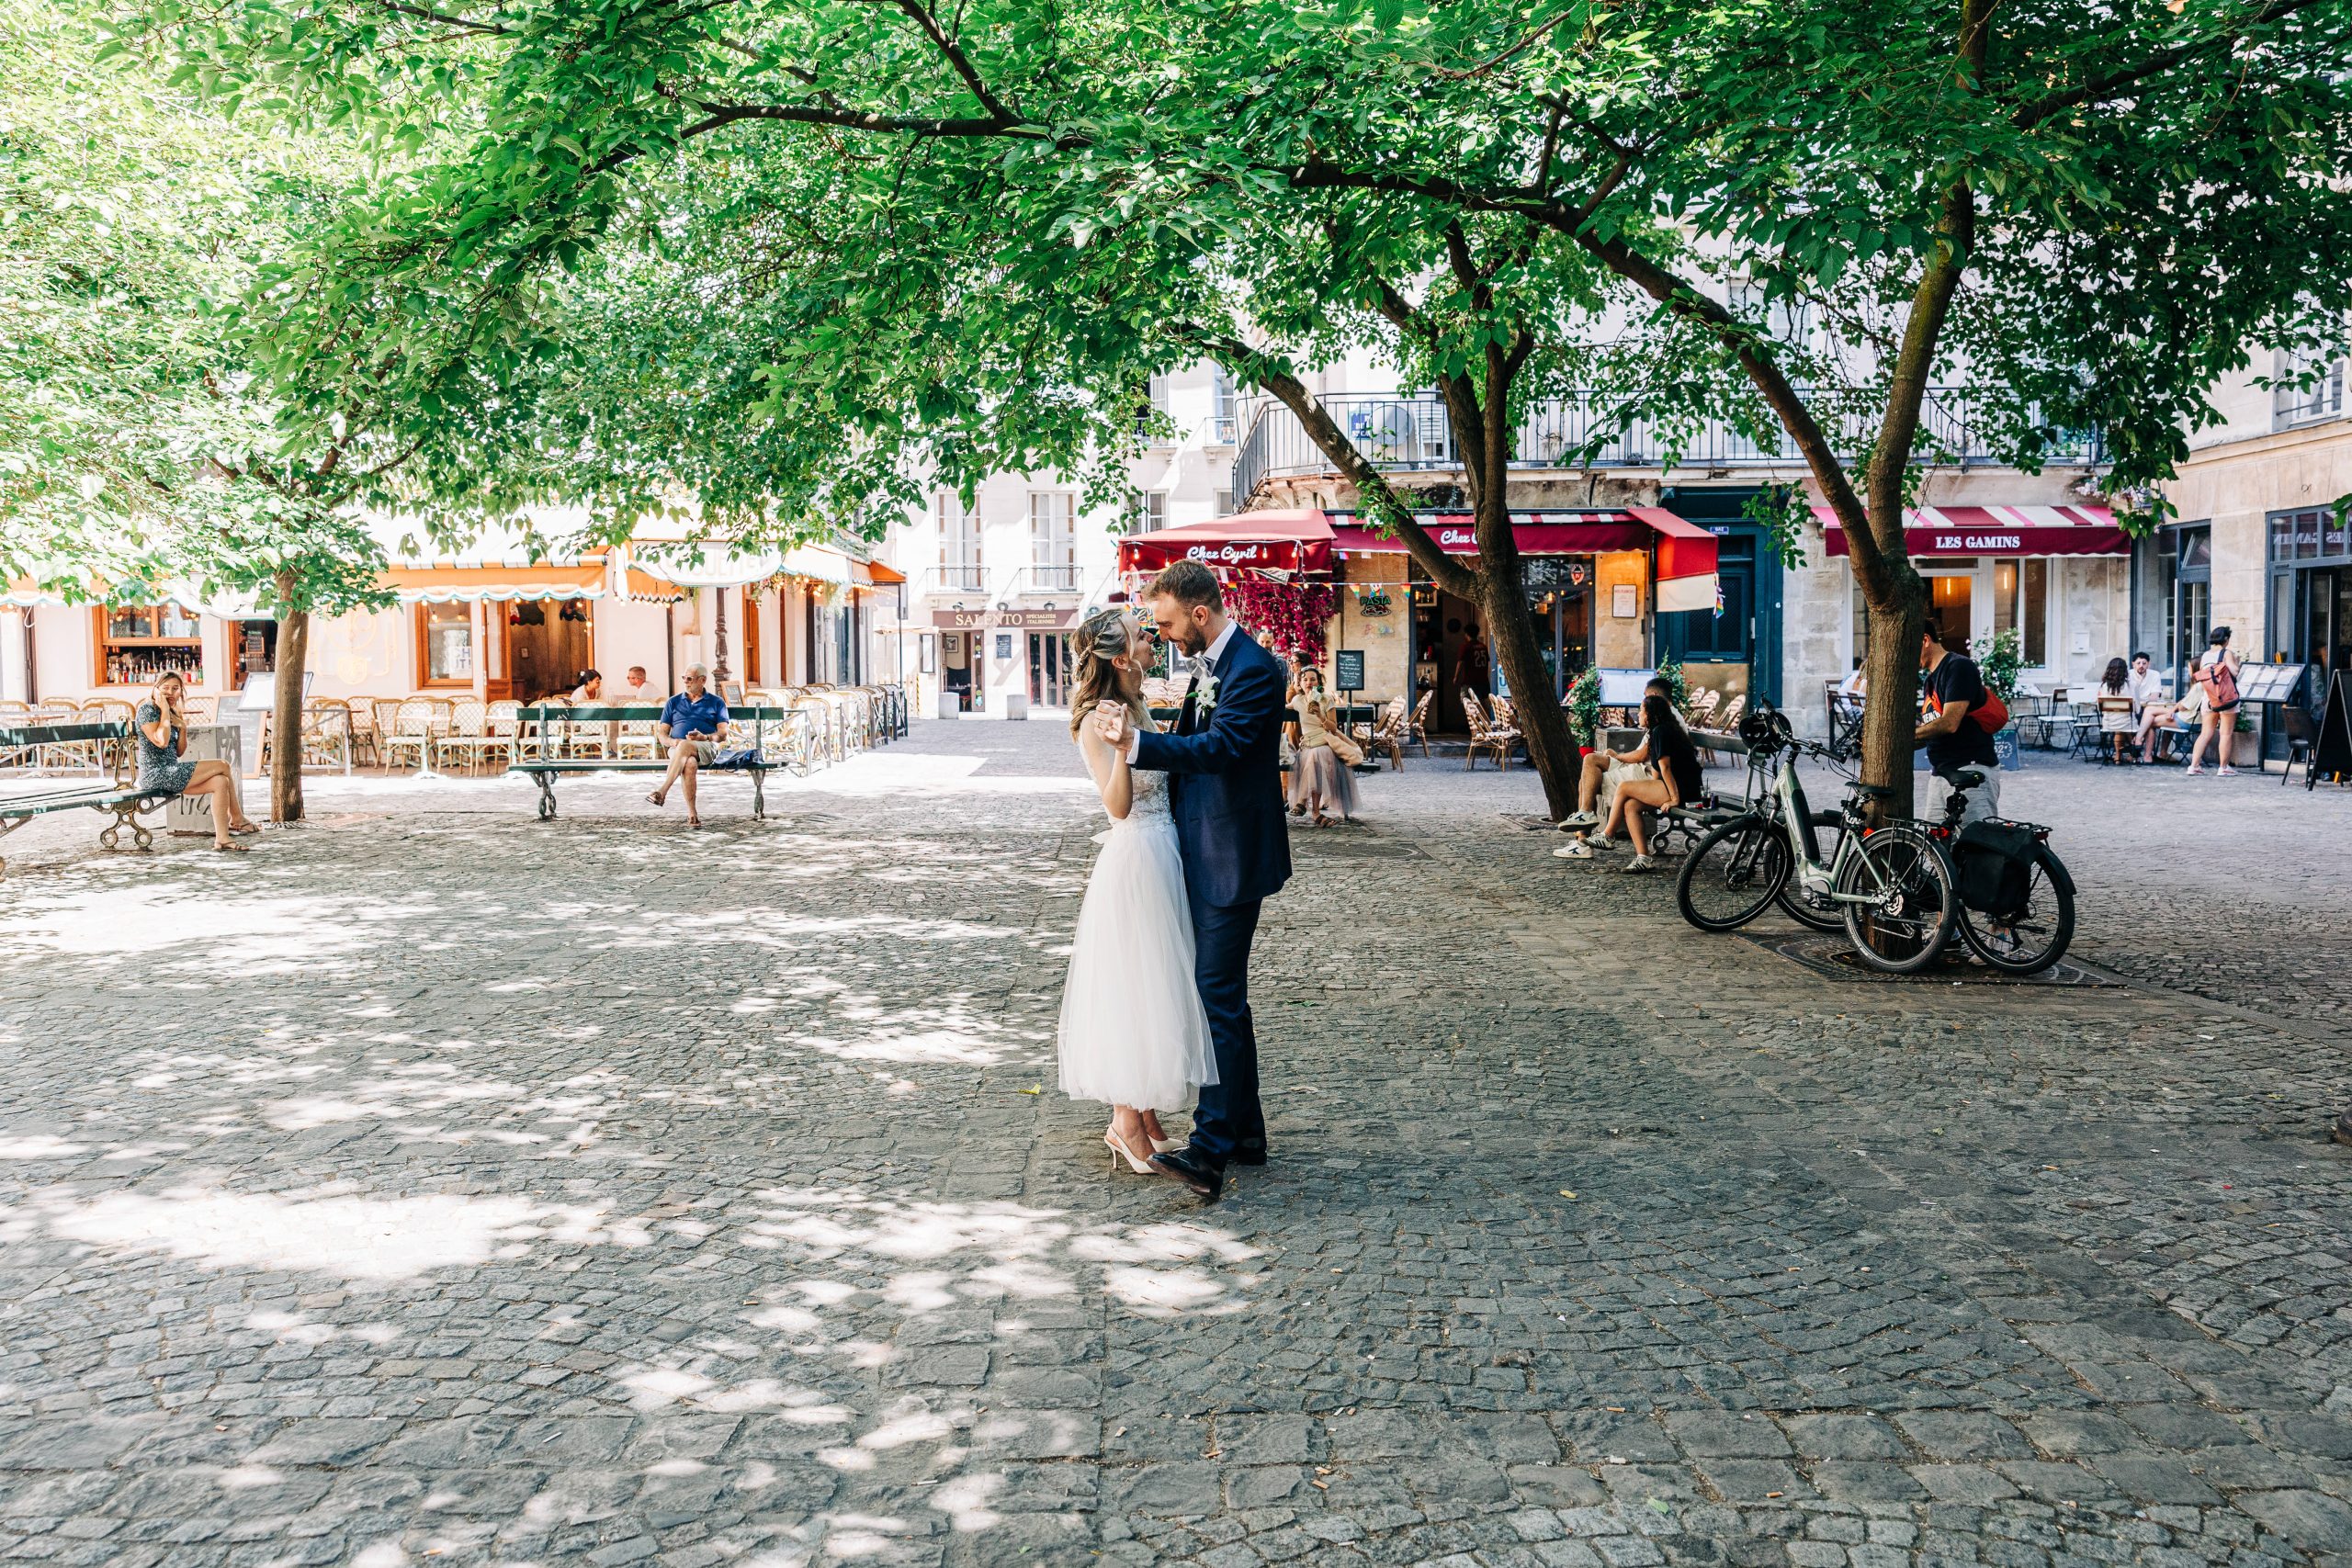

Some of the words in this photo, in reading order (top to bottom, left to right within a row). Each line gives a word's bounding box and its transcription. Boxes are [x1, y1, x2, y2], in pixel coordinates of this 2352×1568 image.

[1441, 529, 1470, 544] Chez
[1936, 536, 1962, 548] LES
[1965, 536, 2020, 548] GAMINS
[1187, 546, 1219, 559] Chez
[1221, 545, 1257, 564] Cyril
[1361, 597, 1391, 605] PASTA
[956, 614, 1023, 626] SALENTO
[1474, 650, 1486, 668] 25
